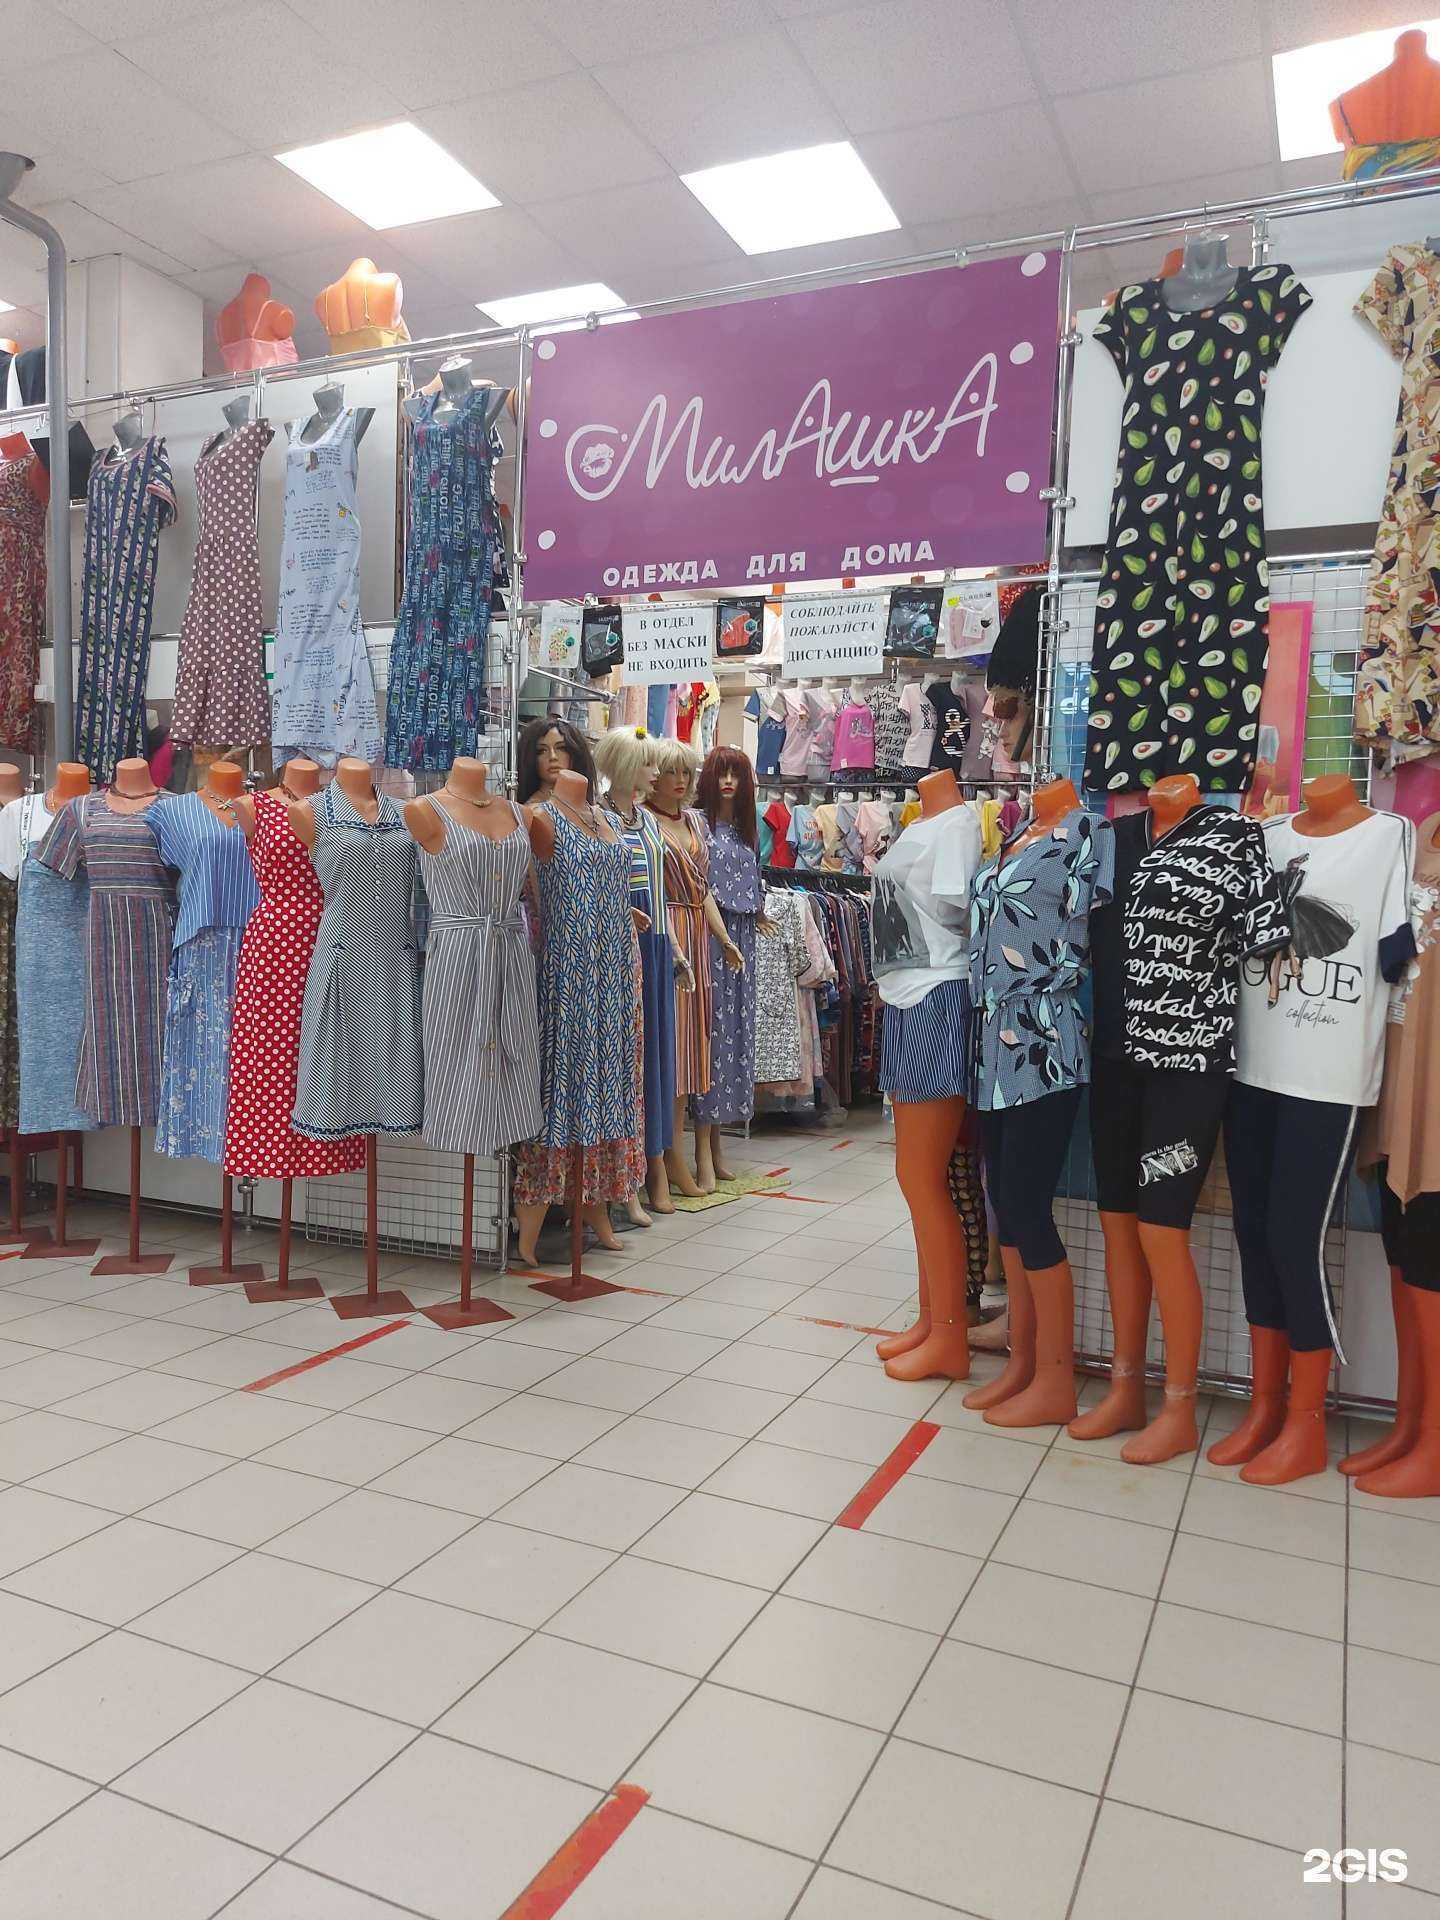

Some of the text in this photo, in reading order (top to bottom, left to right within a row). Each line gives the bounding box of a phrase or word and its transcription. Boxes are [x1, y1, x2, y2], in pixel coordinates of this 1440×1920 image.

[602, 540, 935, 589] ОДЕЖДА ДЛЯ ДОМА
[790, 601, 877, 619] СОБЛЮДАЙТЕ
[640, 616, 695, 630] В ОТДЕЛ
[789, 620, 876, 637] ПОЖАЛУЙСТА
[628, 635, 708, 652] БЕЗ МАСКИ
[786, 645, 879, 665] ДИСТАНЦИЮ
[628, 657, 708, 672] НЕ ВХОДИТЬ
[1285, 999, 1341, 1029] collection
